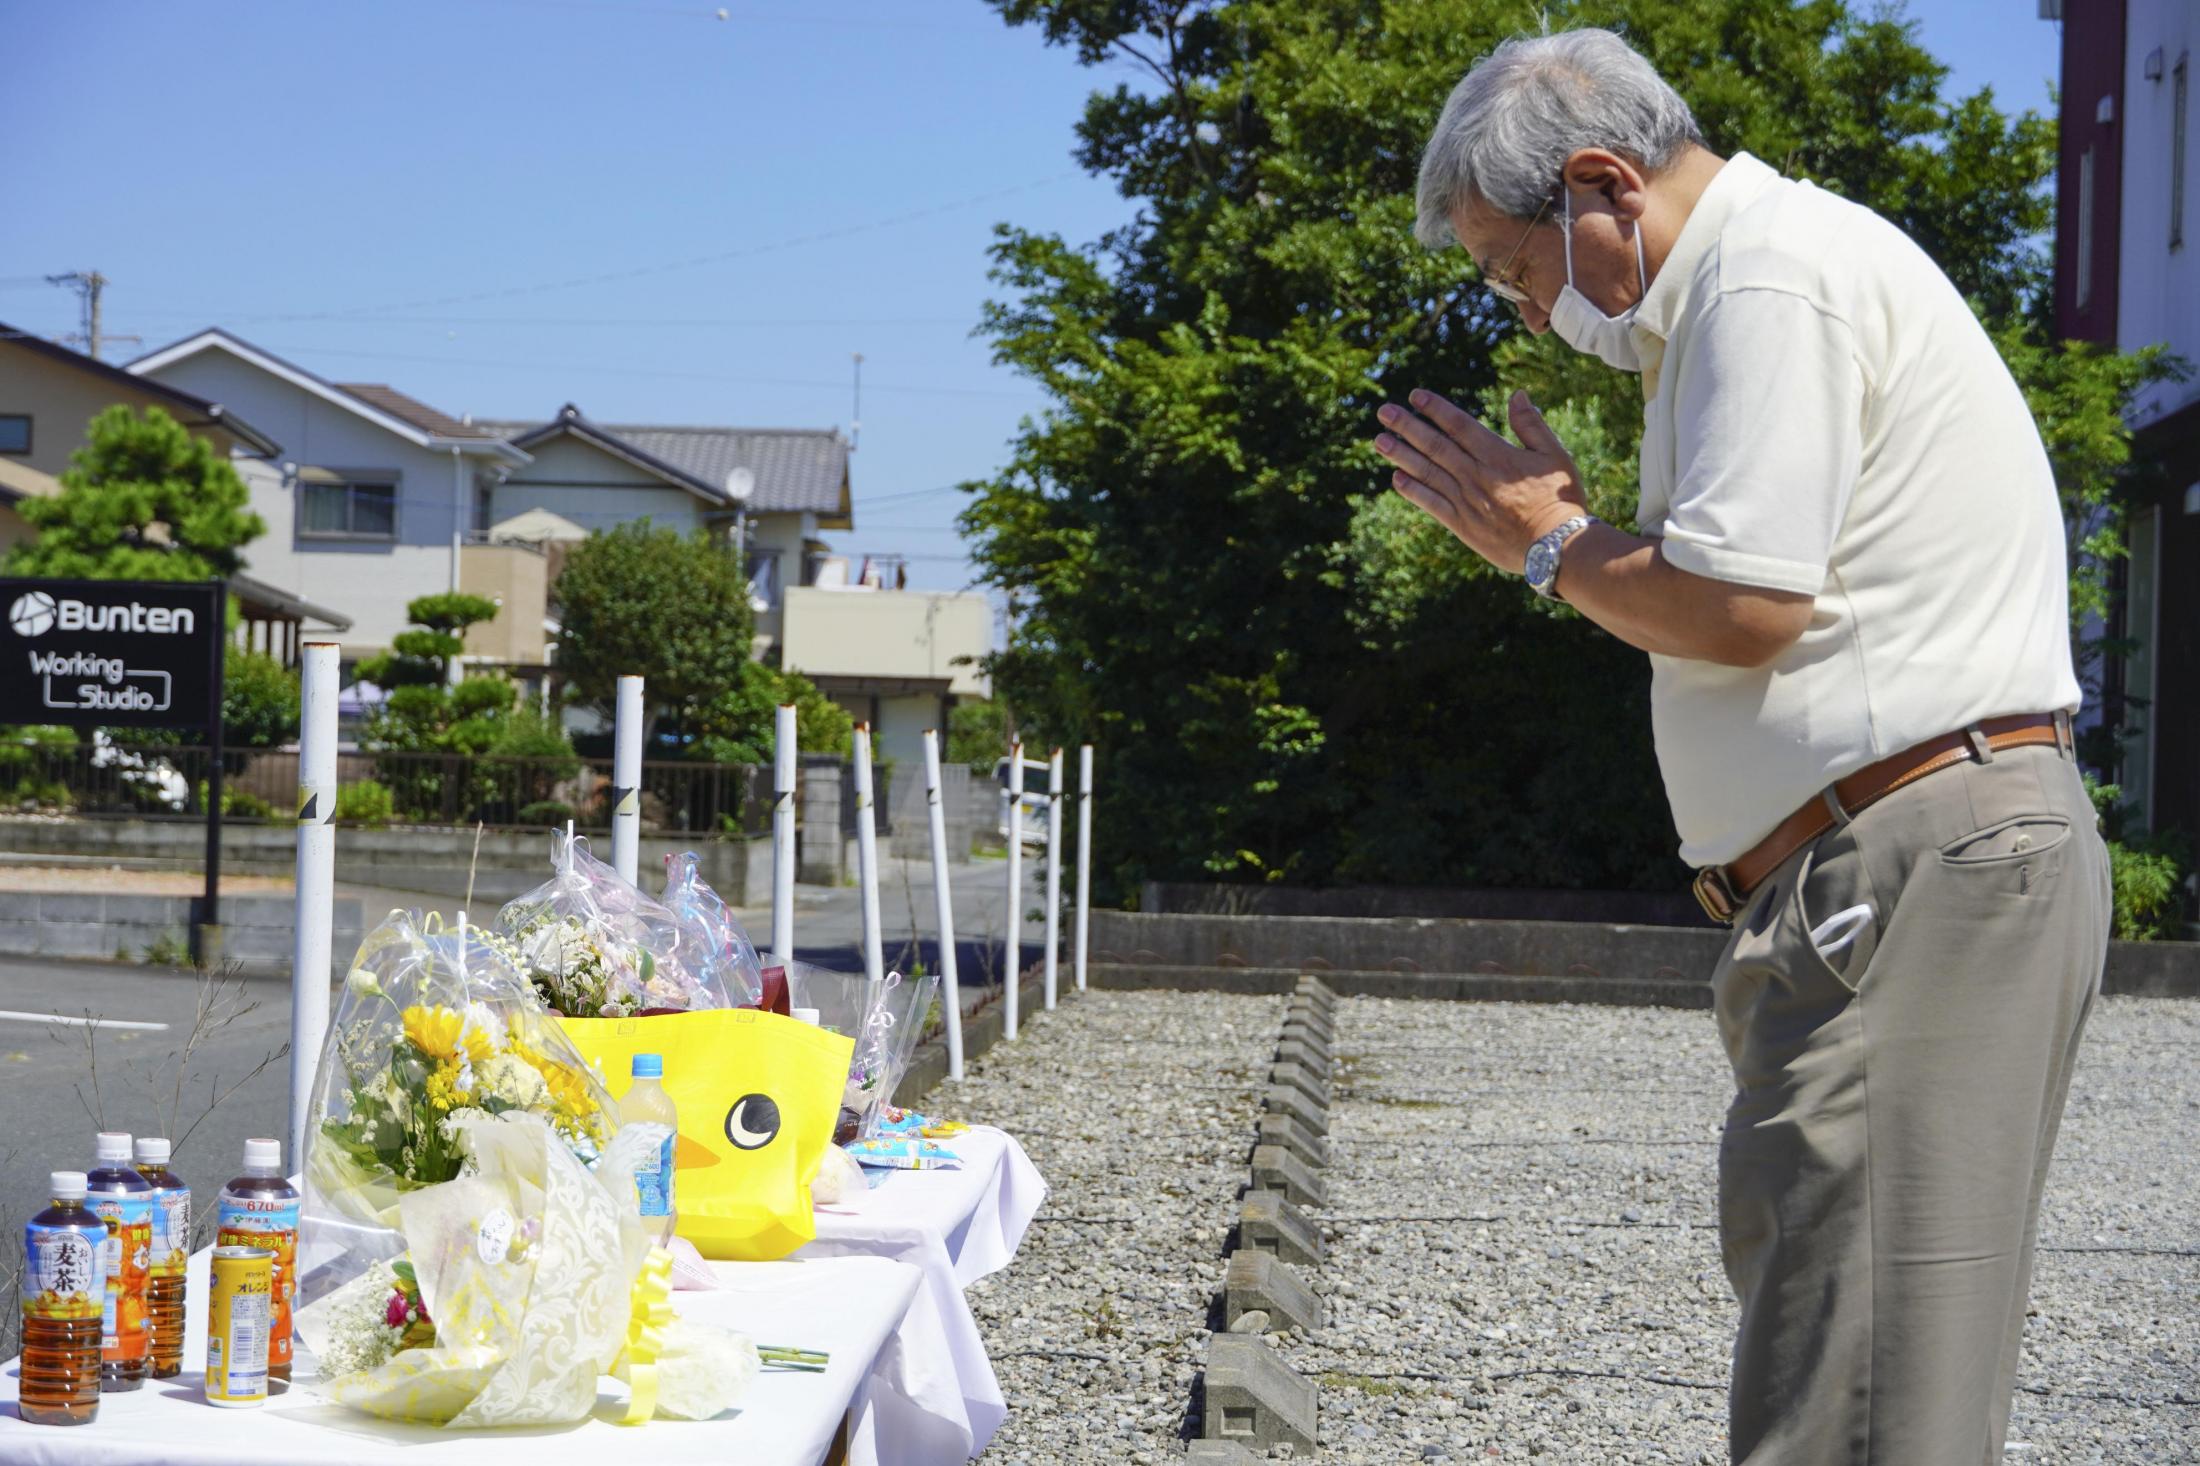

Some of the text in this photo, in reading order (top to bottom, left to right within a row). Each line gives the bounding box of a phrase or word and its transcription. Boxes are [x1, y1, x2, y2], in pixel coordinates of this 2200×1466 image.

[57, 599, 195, 635] Bunten
[28, 650, 124, 685] Working
[77, 684, 154, 711] Studio
[53, 1242, 77, 1292] 麦茶
